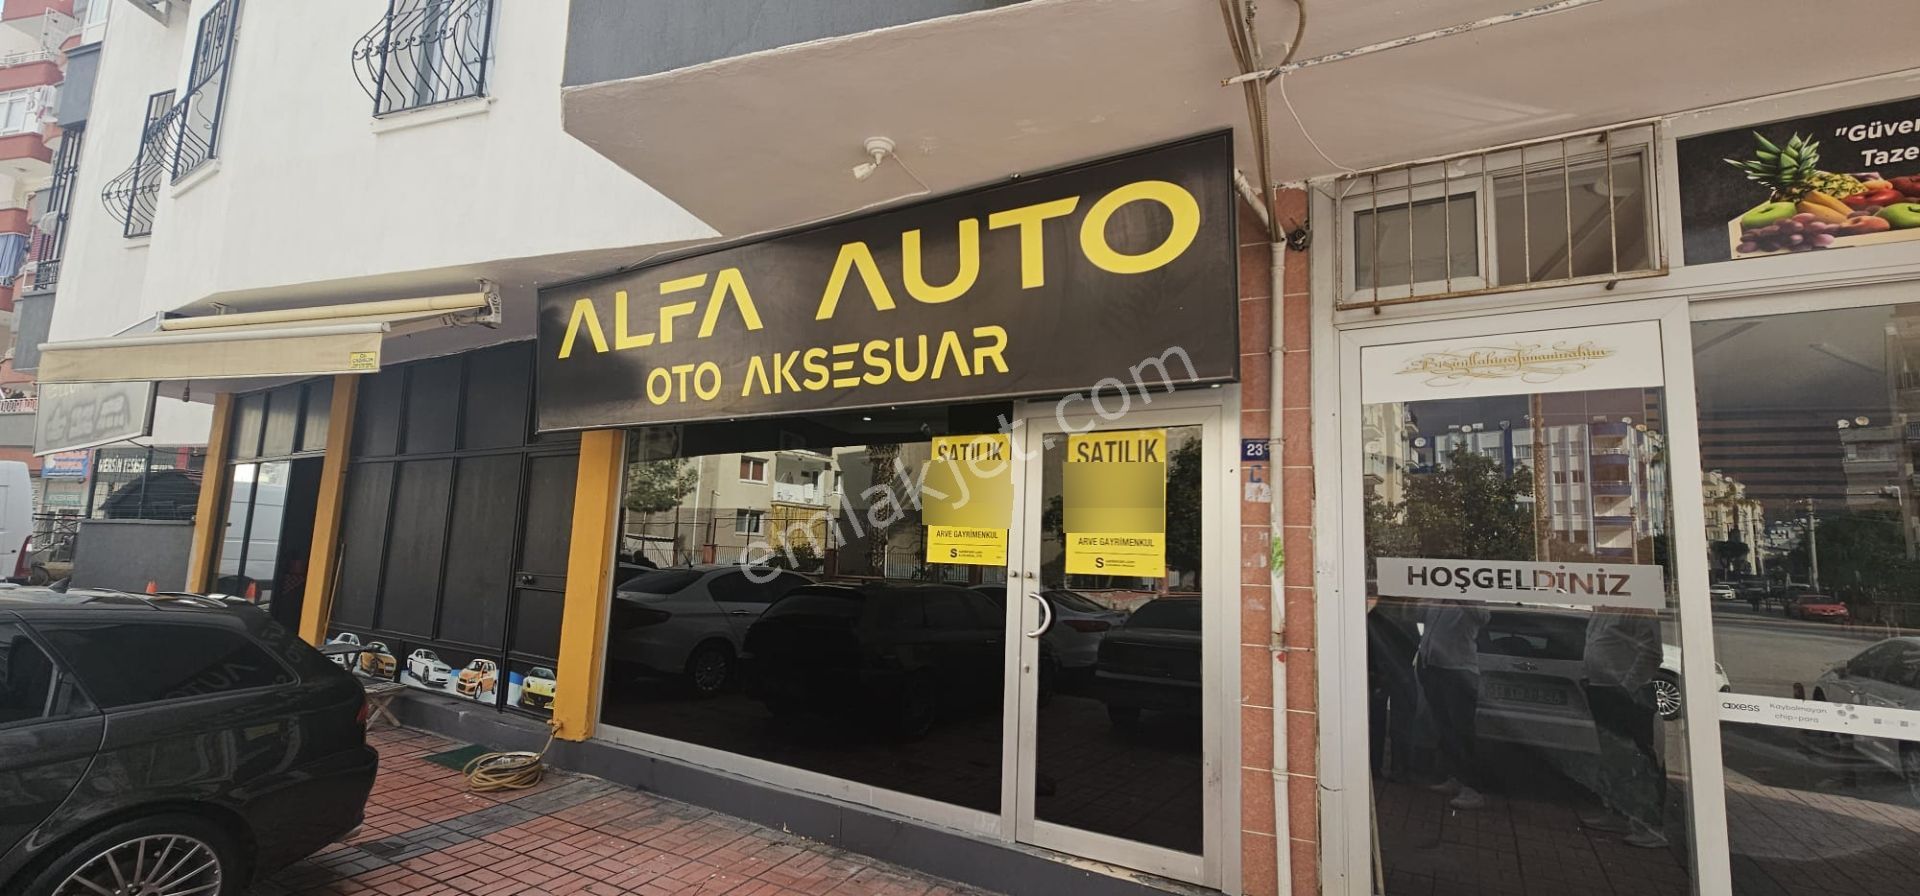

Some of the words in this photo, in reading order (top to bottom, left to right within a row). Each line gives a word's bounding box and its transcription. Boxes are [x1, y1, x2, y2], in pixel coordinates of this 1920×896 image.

[1860, 146, 1920, 167] Taze
[558, 268, 763, 359] ALFA
[815, 180, 1201, 321] AUTO
[646, 361, 722, 406] OTO
[742, 325, 1010, 397] AKSESUAR
[937, 441, 1004, 461] SATILIK
[1076, 438, 1159, 463] SATILIK
[936, 530, 952, 538] ARVE
[954, 529, 999, 539] GAYRİMENKUL
[1078, 537, 1097, 546] ARVE
[1100, 536, 1155, 547] GAYRİMENKUL
[1407, 565, 1632, 597] HOŞGELDİNİZ
[1722, 701, 1760, 712] axess
[1775, 713, 1819, 724] chip-para
